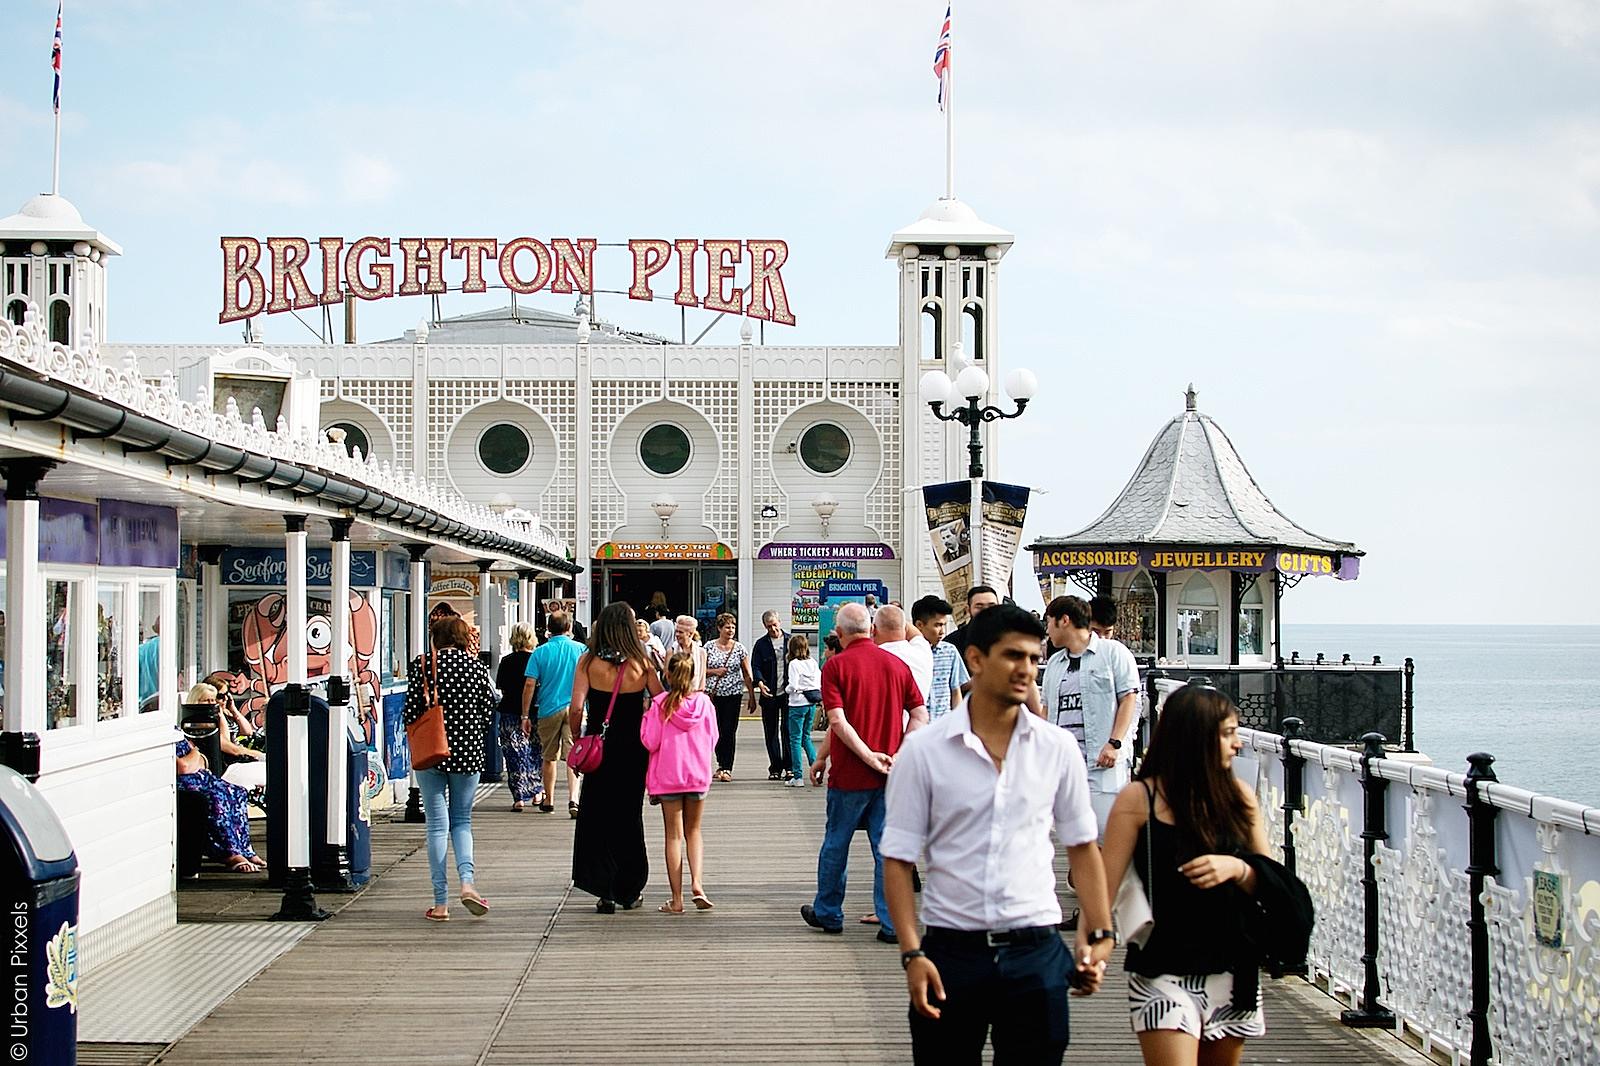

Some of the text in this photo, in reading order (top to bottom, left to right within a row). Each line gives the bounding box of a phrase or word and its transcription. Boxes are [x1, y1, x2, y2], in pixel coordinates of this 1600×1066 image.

[220, 237, 796, 326] BRIGHTON PIER
[770, 547, 884, 558] WHERE TICKETS MAKE PRIZES
[1041, 550, 1138, 567] ACCESSORIES
[793, 563, 812, 572] COME
[813, 562, 828, 571] AND
[842, 561, 856, 569] OUR
[1150, 552, 1266, 568] JEWELLERY
[1279, 552, 1333, 574] GIFTS
[229, 555, 287, 584] Seafoo
[794, 569, 854, 580] REDEMPTION
[448, 579, 473, 593] Trader
[829, 583, 878, 592] BRIGHTON PIER
[793, 607, 819, 616] WHER
